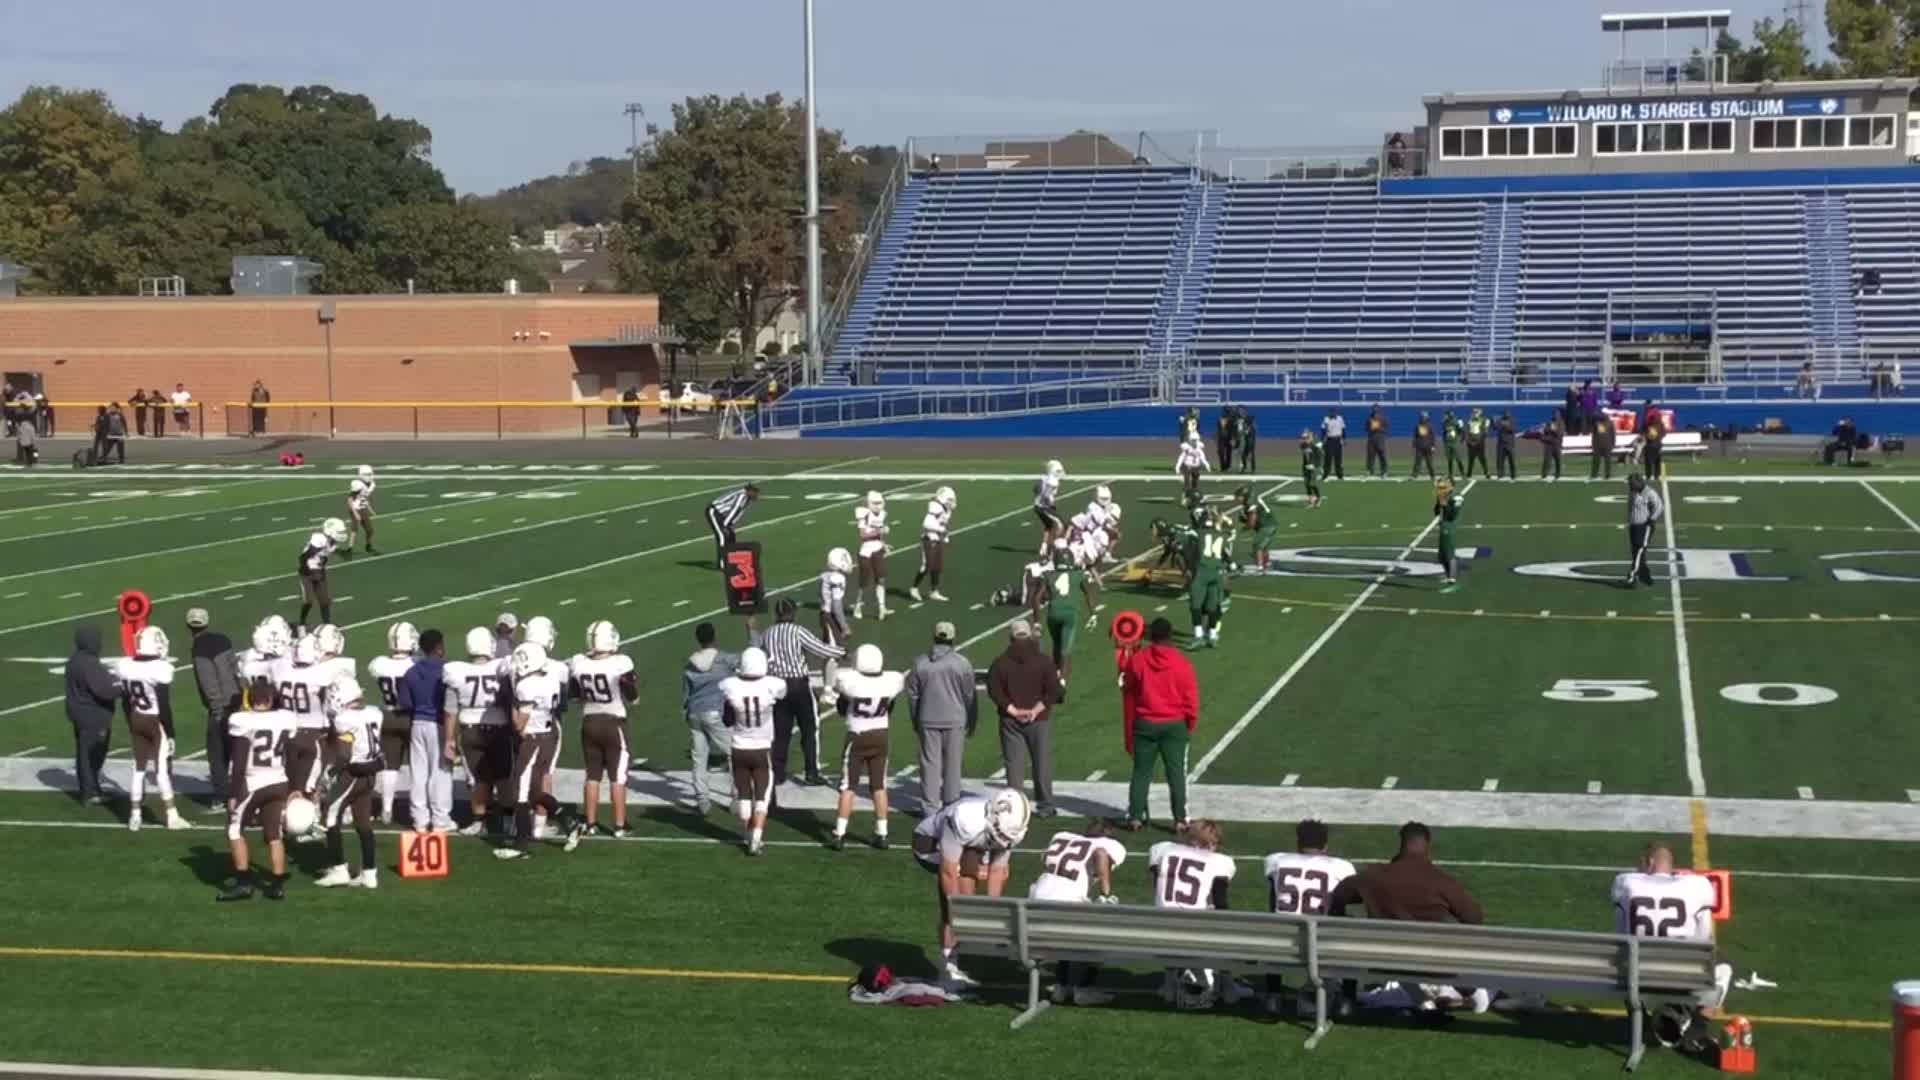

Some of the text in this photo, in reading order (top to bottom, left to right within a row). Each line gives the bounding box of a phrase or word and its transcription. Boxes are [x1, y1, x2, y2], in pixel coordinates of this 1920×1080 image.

[1547, 104, 1616, 122] WILLARD
[1639, 102, 1707, 119] STARGEL
[1710, 99, 1783, 117] STADIUM
[1055, 572, 1070, 596] 4
[465, 675, 500, 708] 75
[579, 673, 612, 704] 69
[743, 696, 762, 728] 11
[407, 835, 442, 871] 40
[1047, 838, 1092, 881] 22
[1164, 855, 1206, 906] 15
[1277, 867, 1329, 914] 52
[1630, 896, 1686, 937] 62
